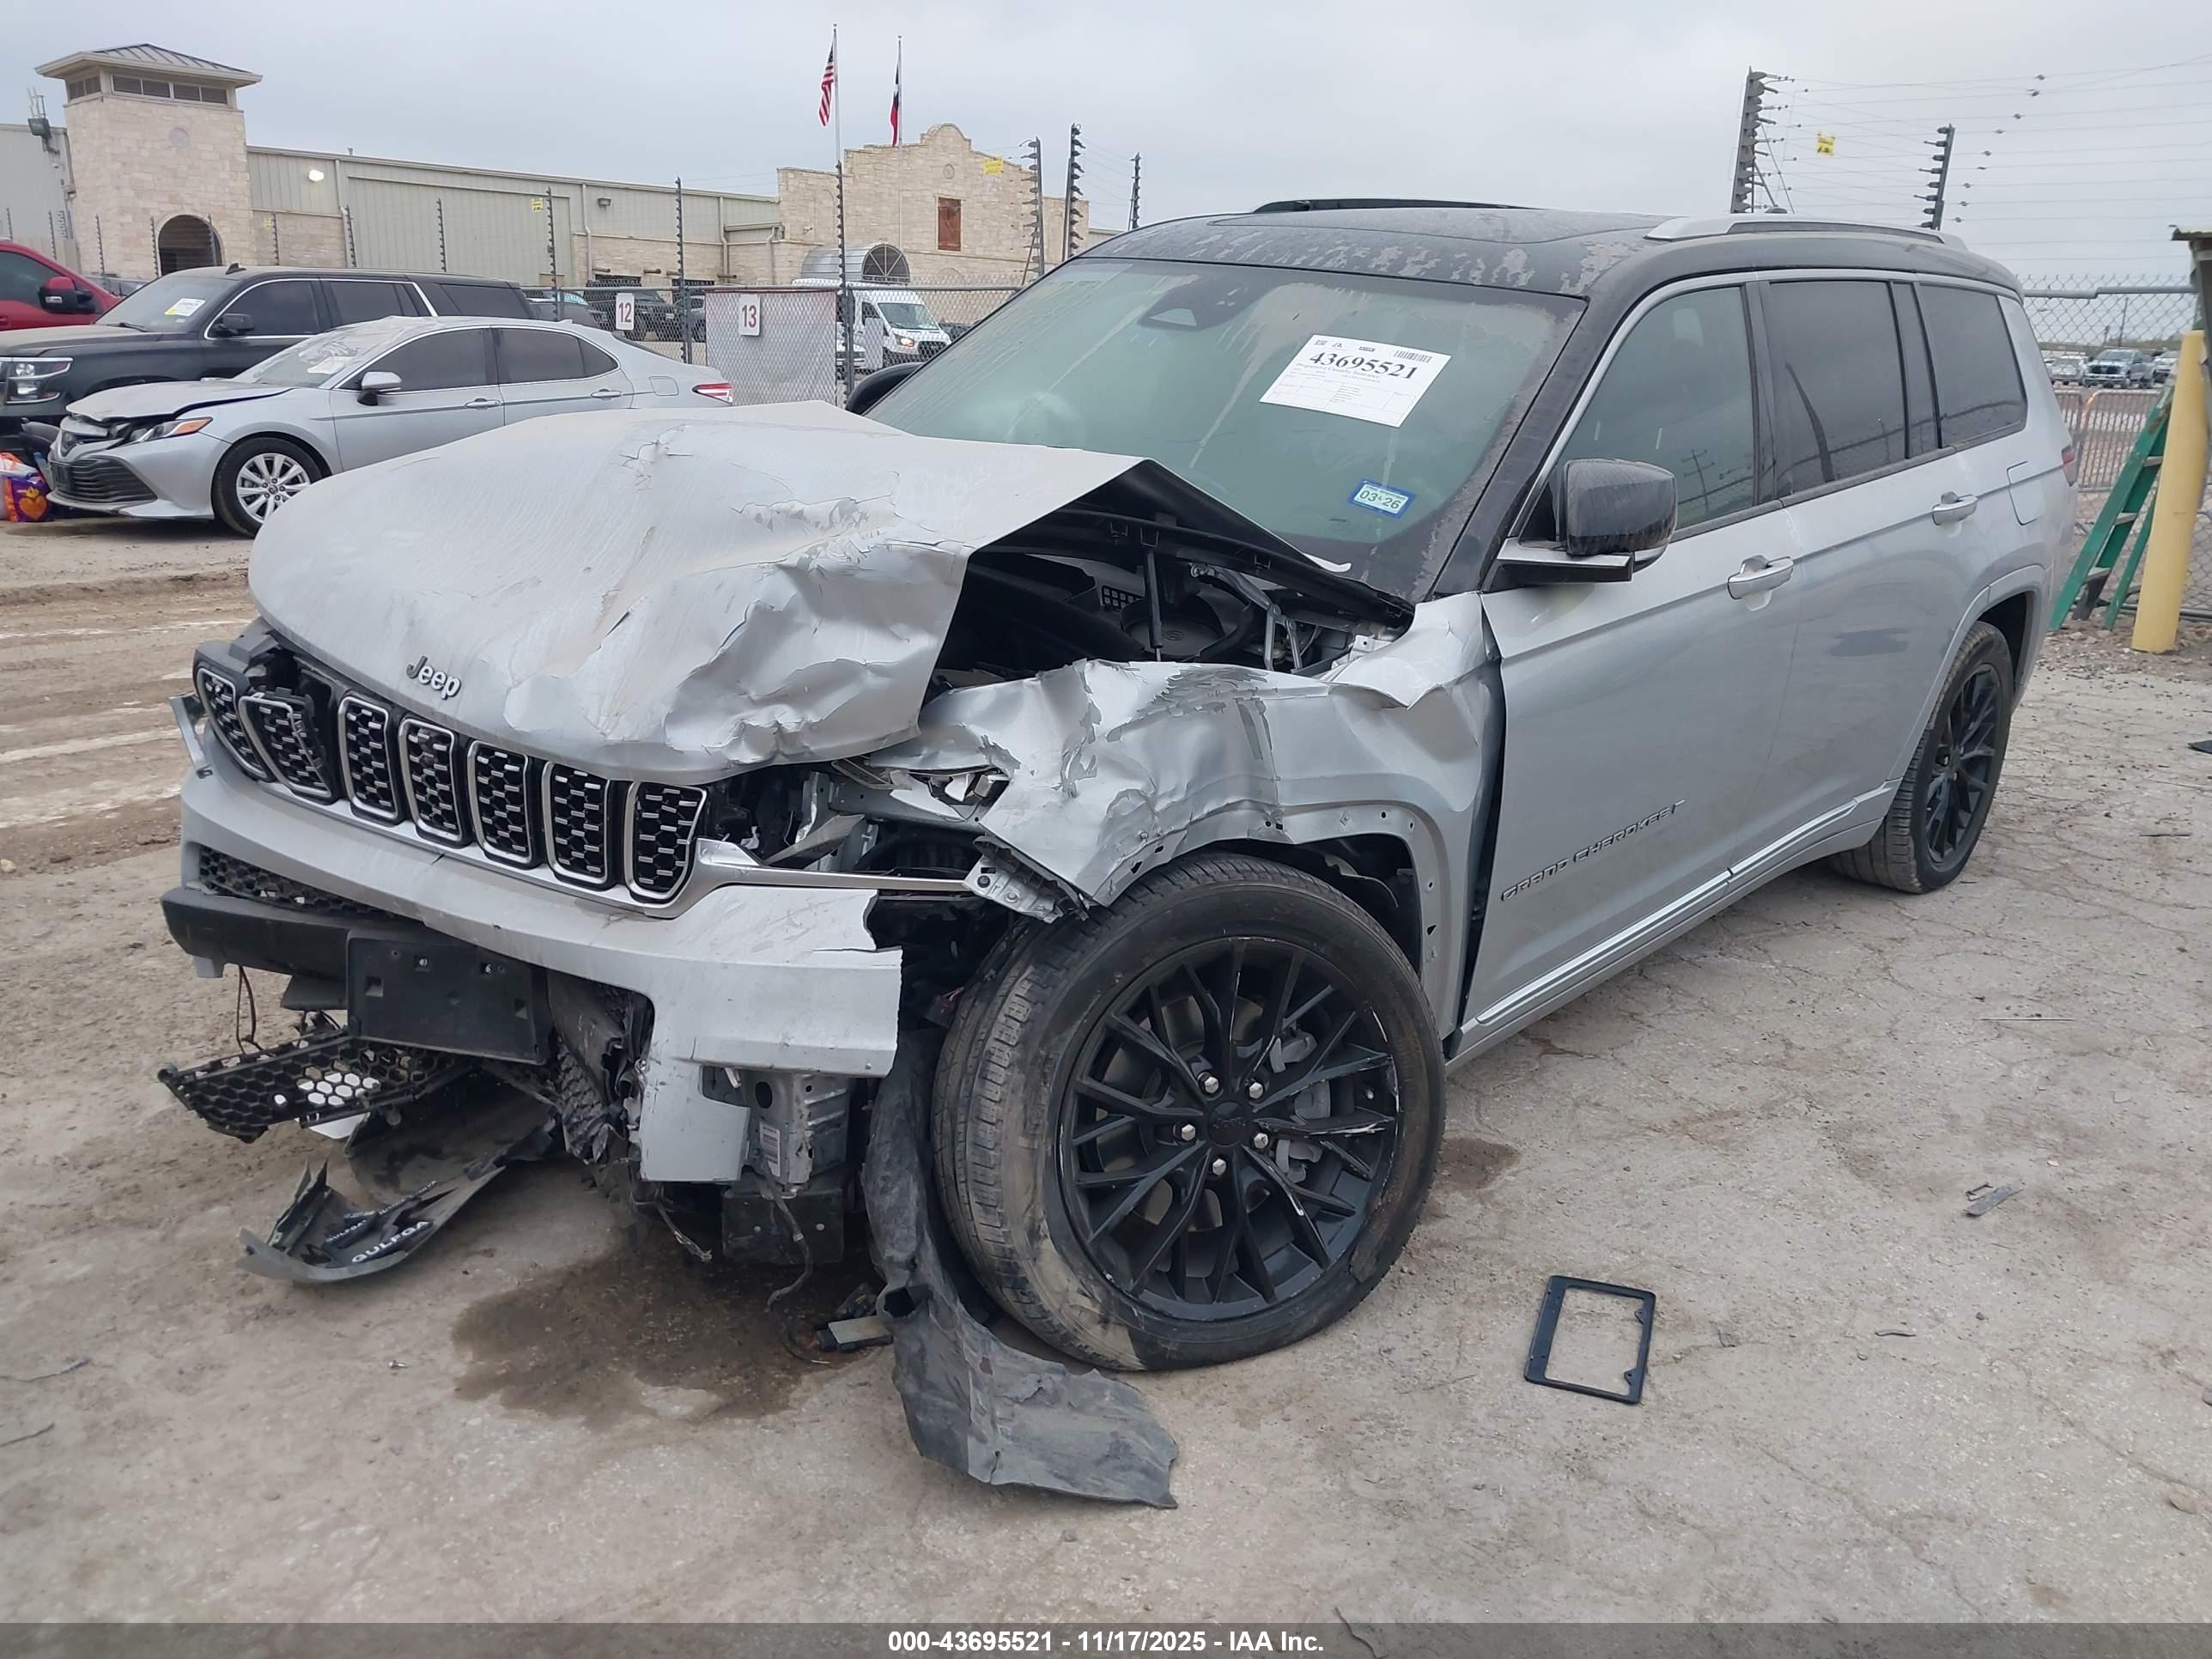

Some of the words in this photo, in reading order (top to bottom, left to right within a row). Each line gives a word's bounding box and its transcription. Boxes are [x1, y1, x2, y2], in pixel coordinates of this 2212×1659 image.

[618, 301, 632, 323] 12
[741, 304, 757, 328] 13
[1309, 351, 1419, 380] 43695521
[1359, 489, 1377, 502] 03
[1382, 497, 1401, 509] 26
[406, 655, 461, 701] Jeep
[1501, 858, 1569, 902] GRAND
[1573, 807, 1670, 863] CHEROKEE
